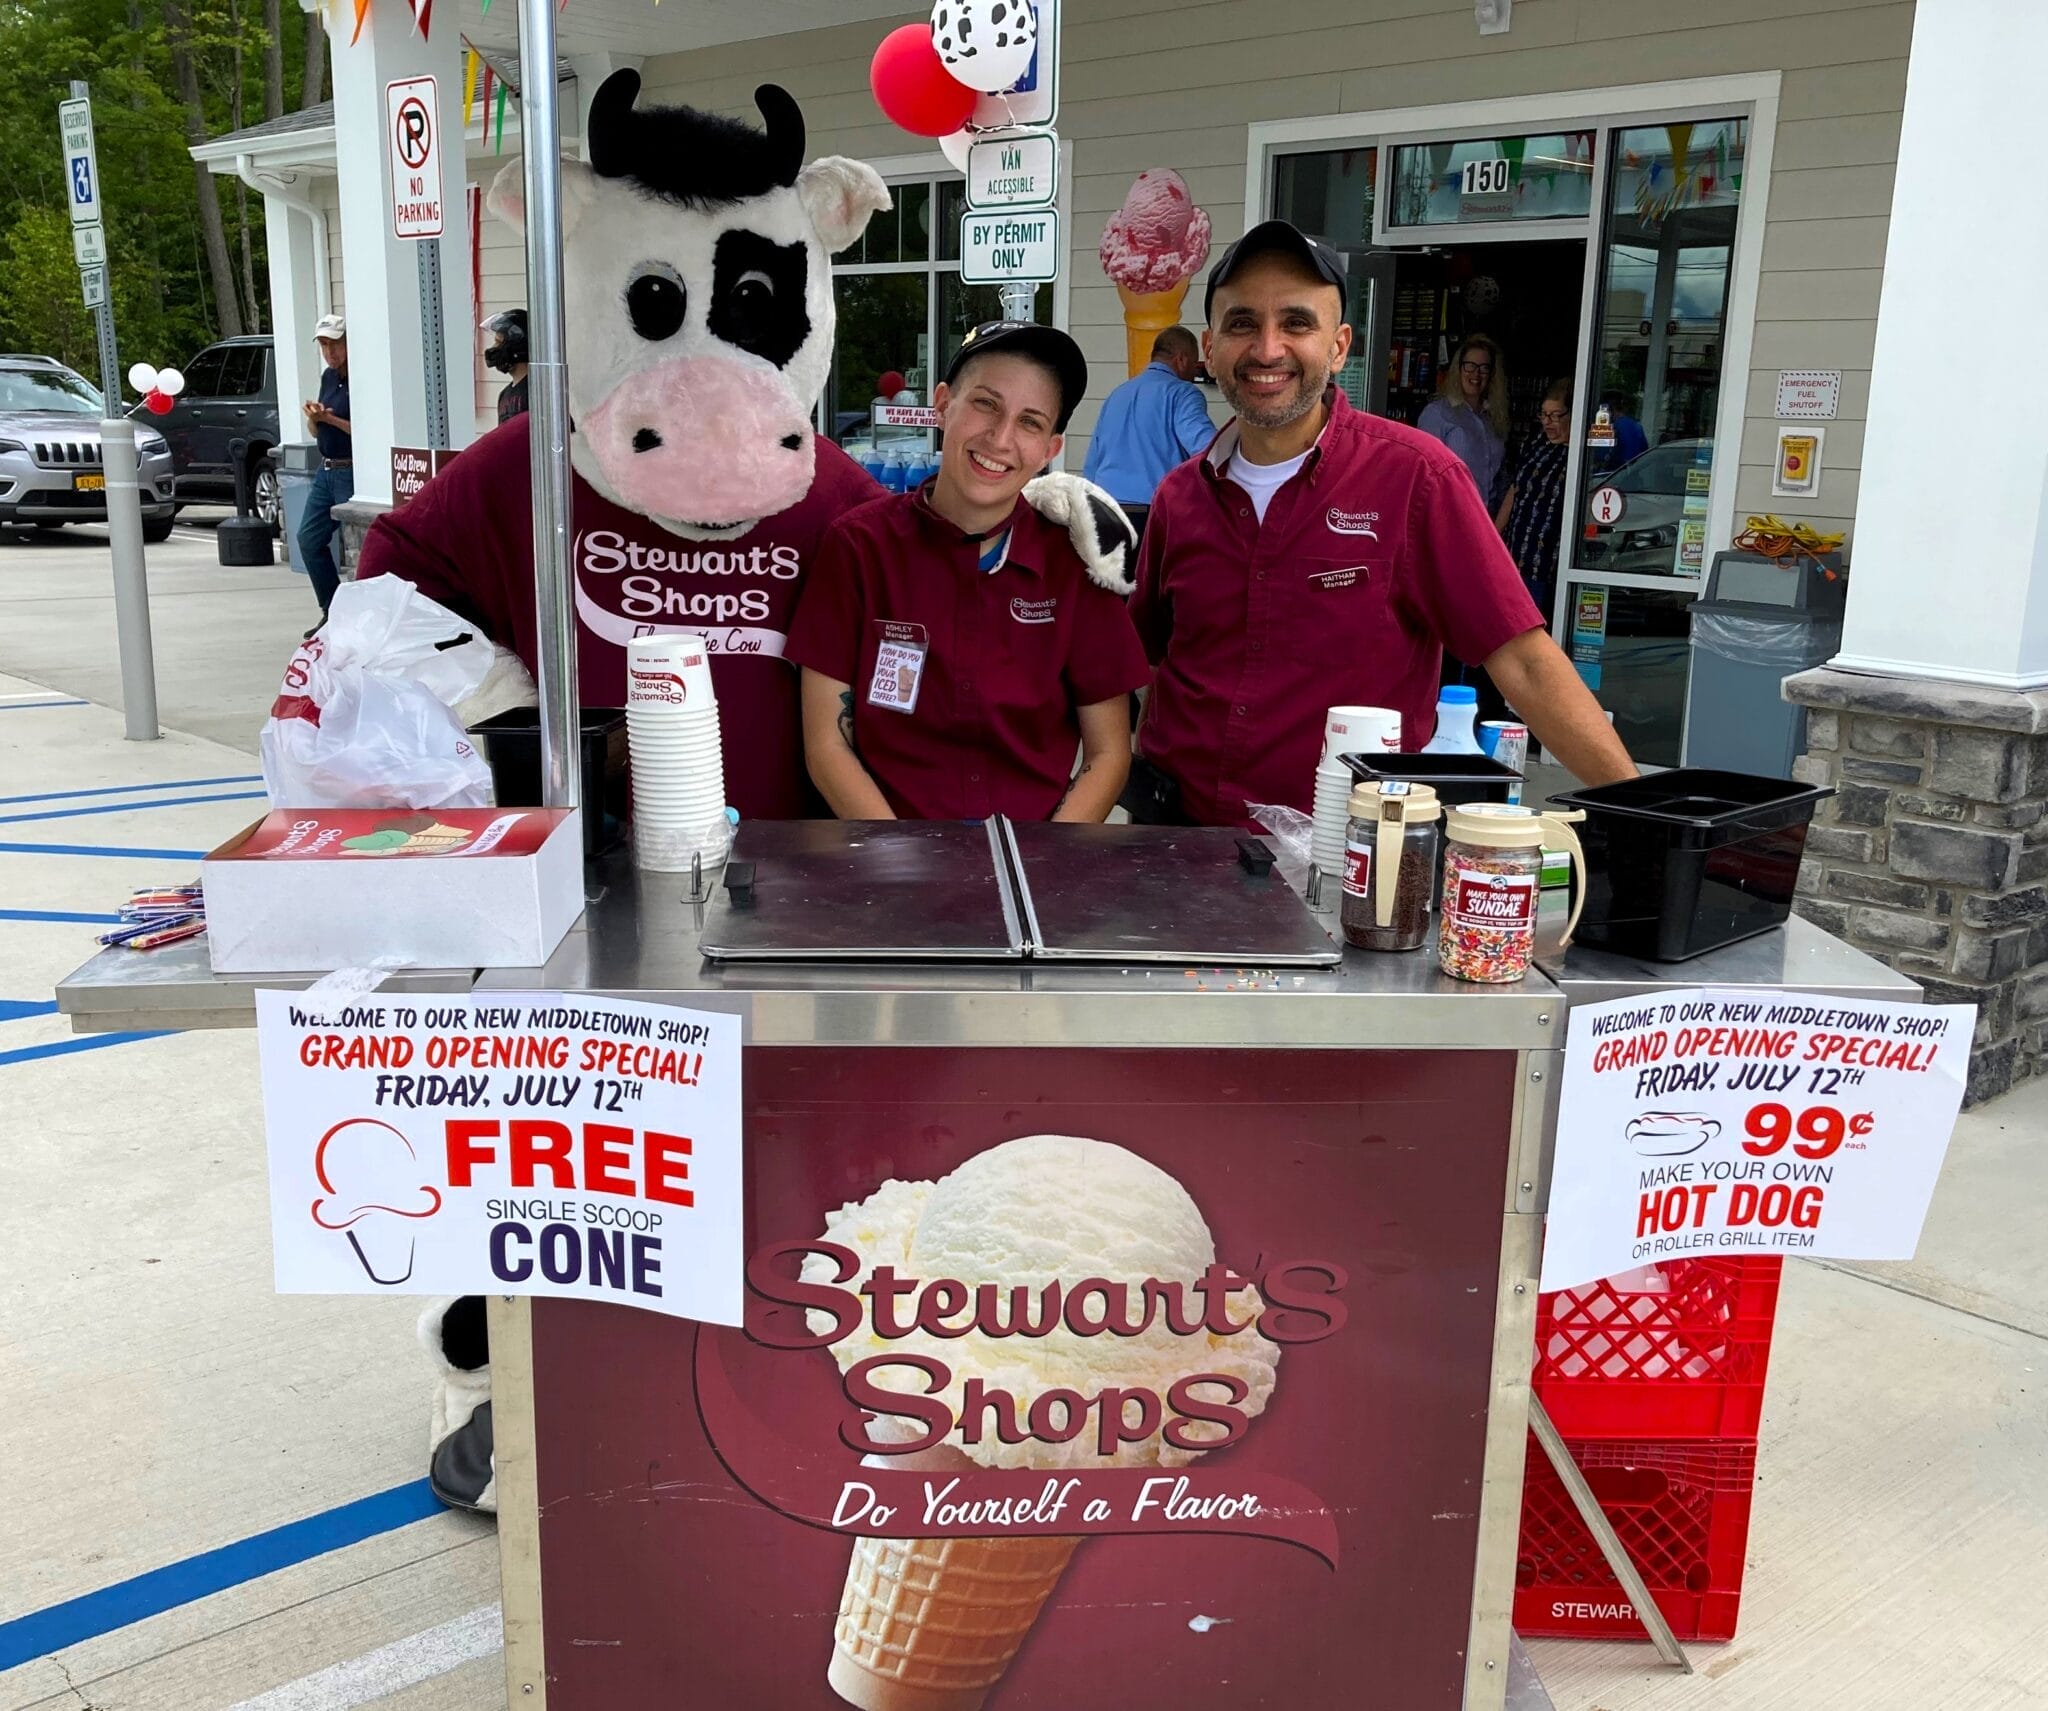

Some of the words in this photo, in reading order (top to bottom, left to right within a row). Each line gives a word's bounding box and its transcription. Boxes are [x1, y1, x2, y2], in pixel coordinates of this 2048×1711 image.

[64, 110, 87, 129] RESERVED
[67, 133, 88, 151] PARKING
[1001, 149, 1021, 171] VAN
[988, 176, 1034, 195] ACCESSIBLE
[1467, 160, 1506, 192] 150
[410, 177, 423, 196] NO
[398, 201, 439, 223] PARKING
[974, 225, 991, 245] BY
[995, 222, 1046, 244] PERMIT
[992, 248, 1025, 269] ONLY
[897, 408, 912, 416] HAVE
[914, 408, 925, 417] ALL
[927, 409, 936, 417] YO
[1788, 401, 1823, 409] SHUTOFF
[888, 416, 900, 424] CAR
[902, 417, 918, 425] CARE
[919, 417, 937, 425] NEED
[394, 453, 407, 472] Cold
[408, 454, 427, 473] Brew
[1603, 491, 1611, 504] V
[1602, 507, 1610, 520] R
[1336, 518, 1371, 530] Shops
[583, 530, 800, 580] Stewart's
[1321, 571, 1356, 582] HAITHAM
[1324, 579, 1356, 588] Manager
[621, 575, 770, 622] Shops
[885, 624, 913, 633] ASHLEY
[885, 631, 914, 640] Manager
[725, 628, 761, 652] Cow
[880, 656, 898, 668] LIKE
[881, 647, 897, 657] HOW
[898, 650, 908, 659] DO
[908, 653, 920, 663] YOU
[877, 667, 896, 678] YOUR
[635, 681, 672, 693] Shops
[874, 679, 896, 692] ICED
[872, 691, 897, 703] COFFEE?
[1466, 889, 1488, 900] MAKE
[1489, 891, 1509, 902] YOUR
[1509, 893, 1526, 902] OWN
[1466, 898, 1521, 917] SUNDAE
[393, 1007, 418, 1029] TO
[424, 1008, 467, 1030] OUR
[474, 1007, 519, 1030] NEW
[527, 1008, 652, 1039] MIDDLETOWN
[658, 1020, 711, 1047] SHOP!
[1592, 1008, 1654, 1038] WELCOME
[1659, 1004, 1675, 1023] TO
[1679, 1003, 1714, 1022] OUR
[1719, 1004, 1762, 1024] NEW
[1766, 1005, 1891, 1033] MIDDLETOWN
[1895, 1016, 1950, 1039] SHOP!
[1592, 1030, 1668, 1073] GRAND
[1673, 1028, 1798, 1059] OPENING
[1802, 1033, 1938, 1073] SPECIAL!
[299, 1035, 415, 1070] GRAND
[425, 1036, 570, 1070] OPENING
[578, 1038, 704, 1087] SPECIAL!
[1634, 1061, 1720, 1099] FRIDAY,
[1726, 1063, 1801, 1093] JULY
[1807, 1067, 1866, 1096] 12TH
[375, 1074, 491, 1109] FRIDAY,
[503, 1074, 582, 1109] JULY
[593, 1079, 644, 1113] 12TH
[1844, 1141, 1867, 1150] each
[444, 1118, 695, 1208] FREE
[1639, 1164, 1694, 1190] MAKE
[1700, 1160, 1766, 1181] YOUR
[1772, 1162, 1834, 1184] OWN
[486, 1199, 577, 1222] SINGLE
[582, 1203, 663, 1234] SCOOP
[1636, 1184, 1718, 1239] HOT
[1725, 1183, 1824, 1230] DOG
[1631, 1244, 1651, 1260] OR
[1654, 1233, 1714, 1257] ROLLER
[1719, 1231, 1767, 1246] GRILL
[1771, 1233, 1816, 1248] ITEM
[489, 1221, 664, 1299] CONE
[743, 1238, 1350, 1351] Stewart's
[838, 1352, 1251, 1457] Shops
[831, 1480, 897, 1529] Do
[919, 1477, 1072, 1527] Yourself
[1085, 1497, 1112, 1523] a
[1129, 1476, 1264, 1523] Flavor
[1551, 1601, 1638, 1620] STEWAR
